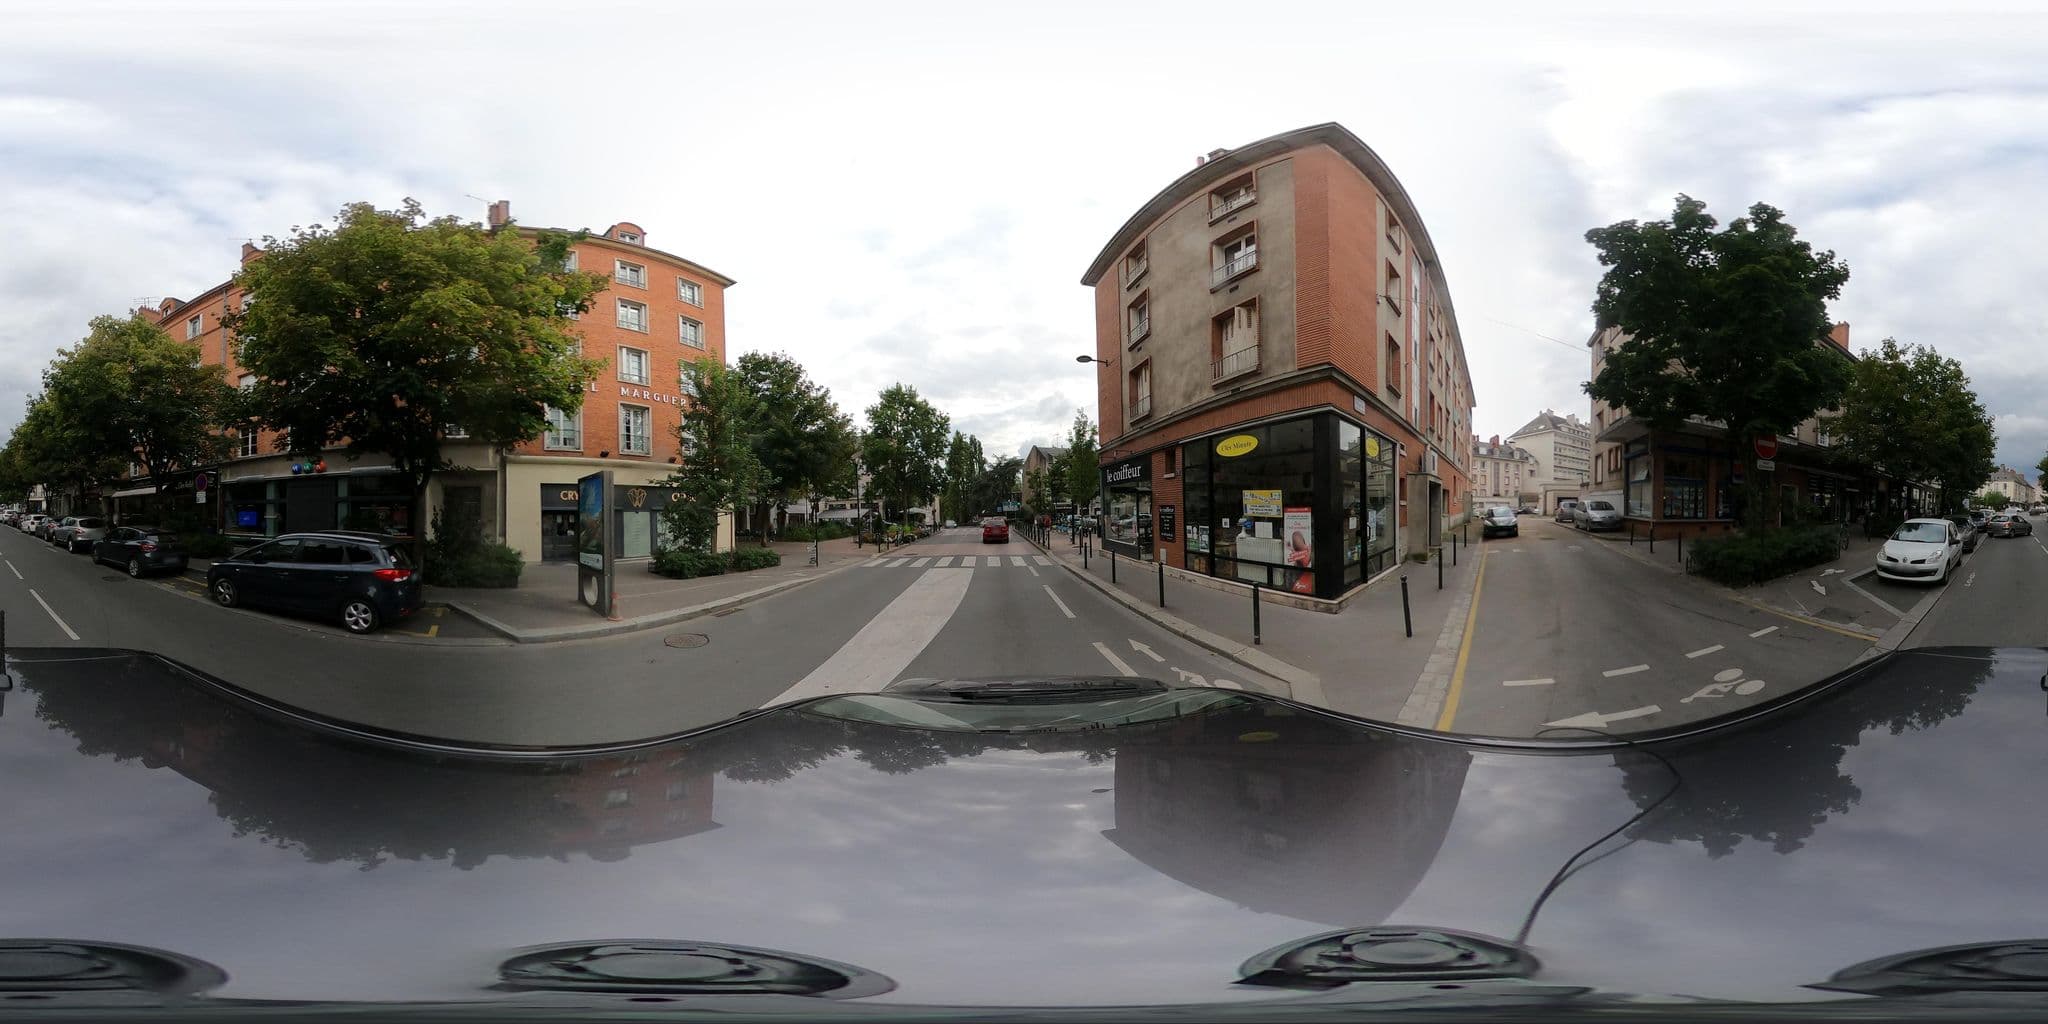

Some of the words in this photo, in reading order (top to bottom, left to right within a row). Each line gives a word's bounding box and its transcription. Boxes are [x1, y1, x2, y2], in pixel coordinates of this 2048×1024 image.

[620, 386, 687, 406] MARGUER
[1106, 469, 1112, 482] le
[1113, 463, 1142, 481] coiffeur
[560, 490, 579, 501] CRY
